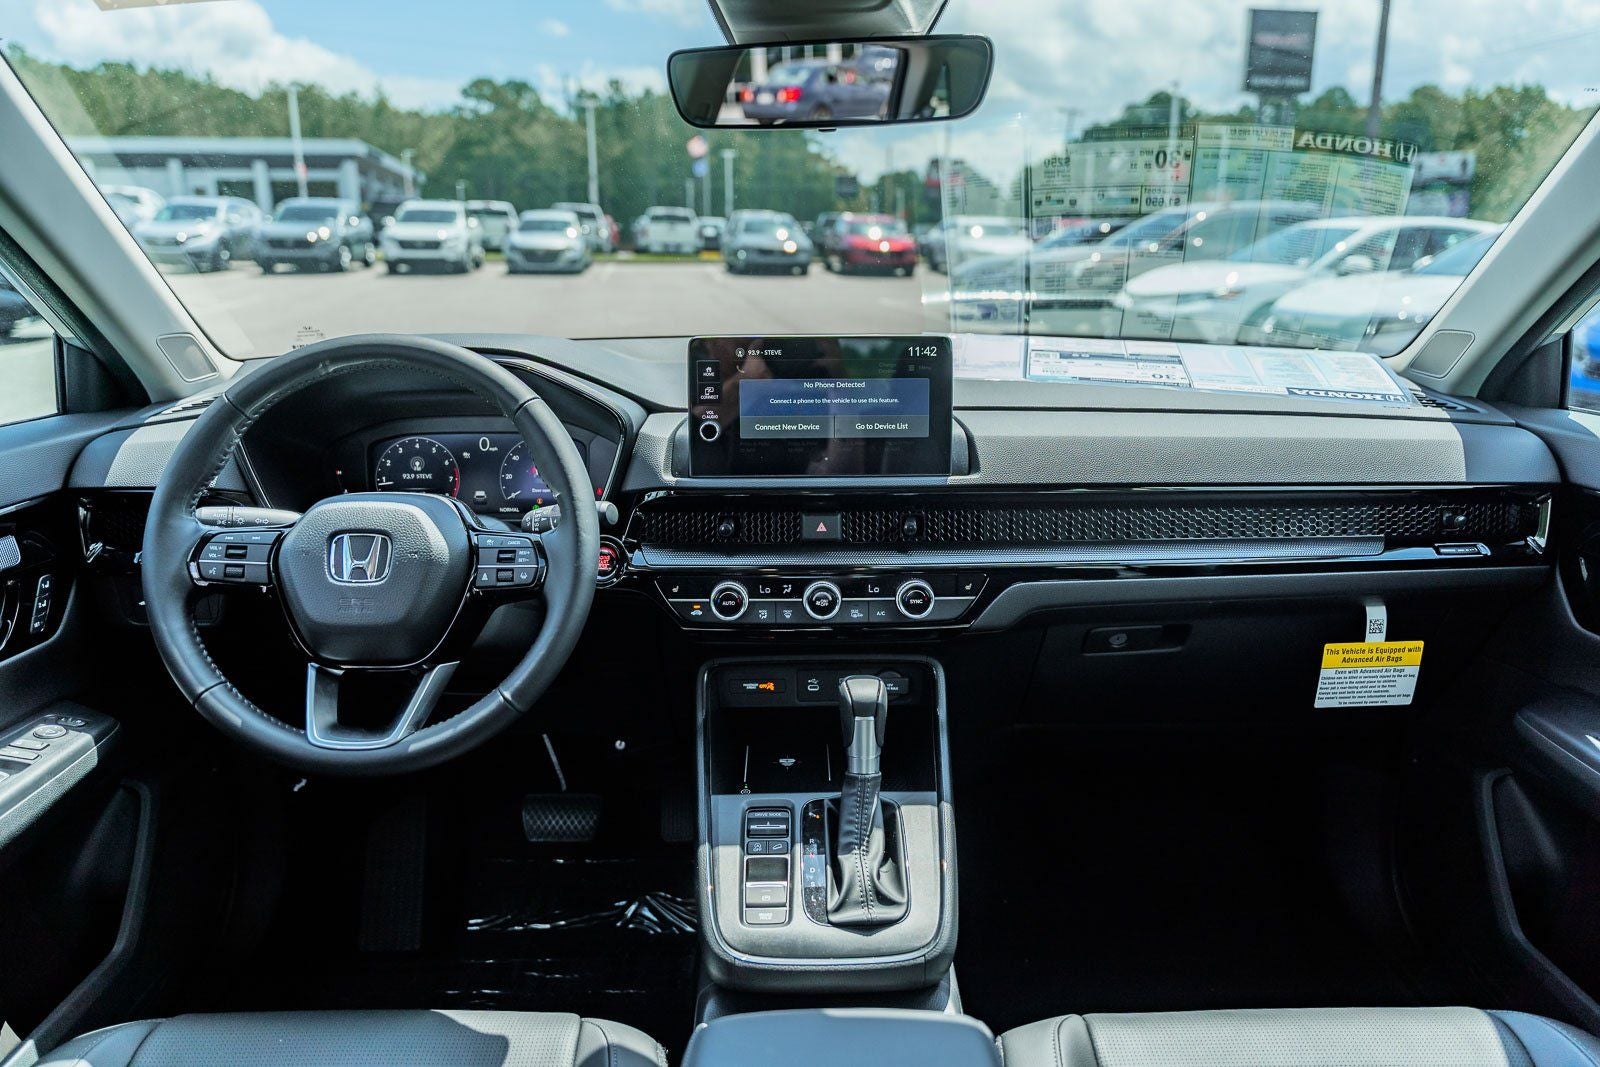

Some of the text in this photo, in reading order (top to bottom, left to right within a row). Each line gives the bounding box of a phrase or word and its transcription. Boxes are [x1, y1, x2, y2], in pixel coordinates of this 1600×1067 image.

[908, 346, 937, 357] 11:42
[1289, 388, 1385, 401] HONDA
[479, 436, 490, 451] 0
[759, 584, 771, 594] Lo
[868, 584, 880, 593] Lo
[1375, 646, 1406, 655] Equipped
[1386, 655, 1403, 663] Bags
